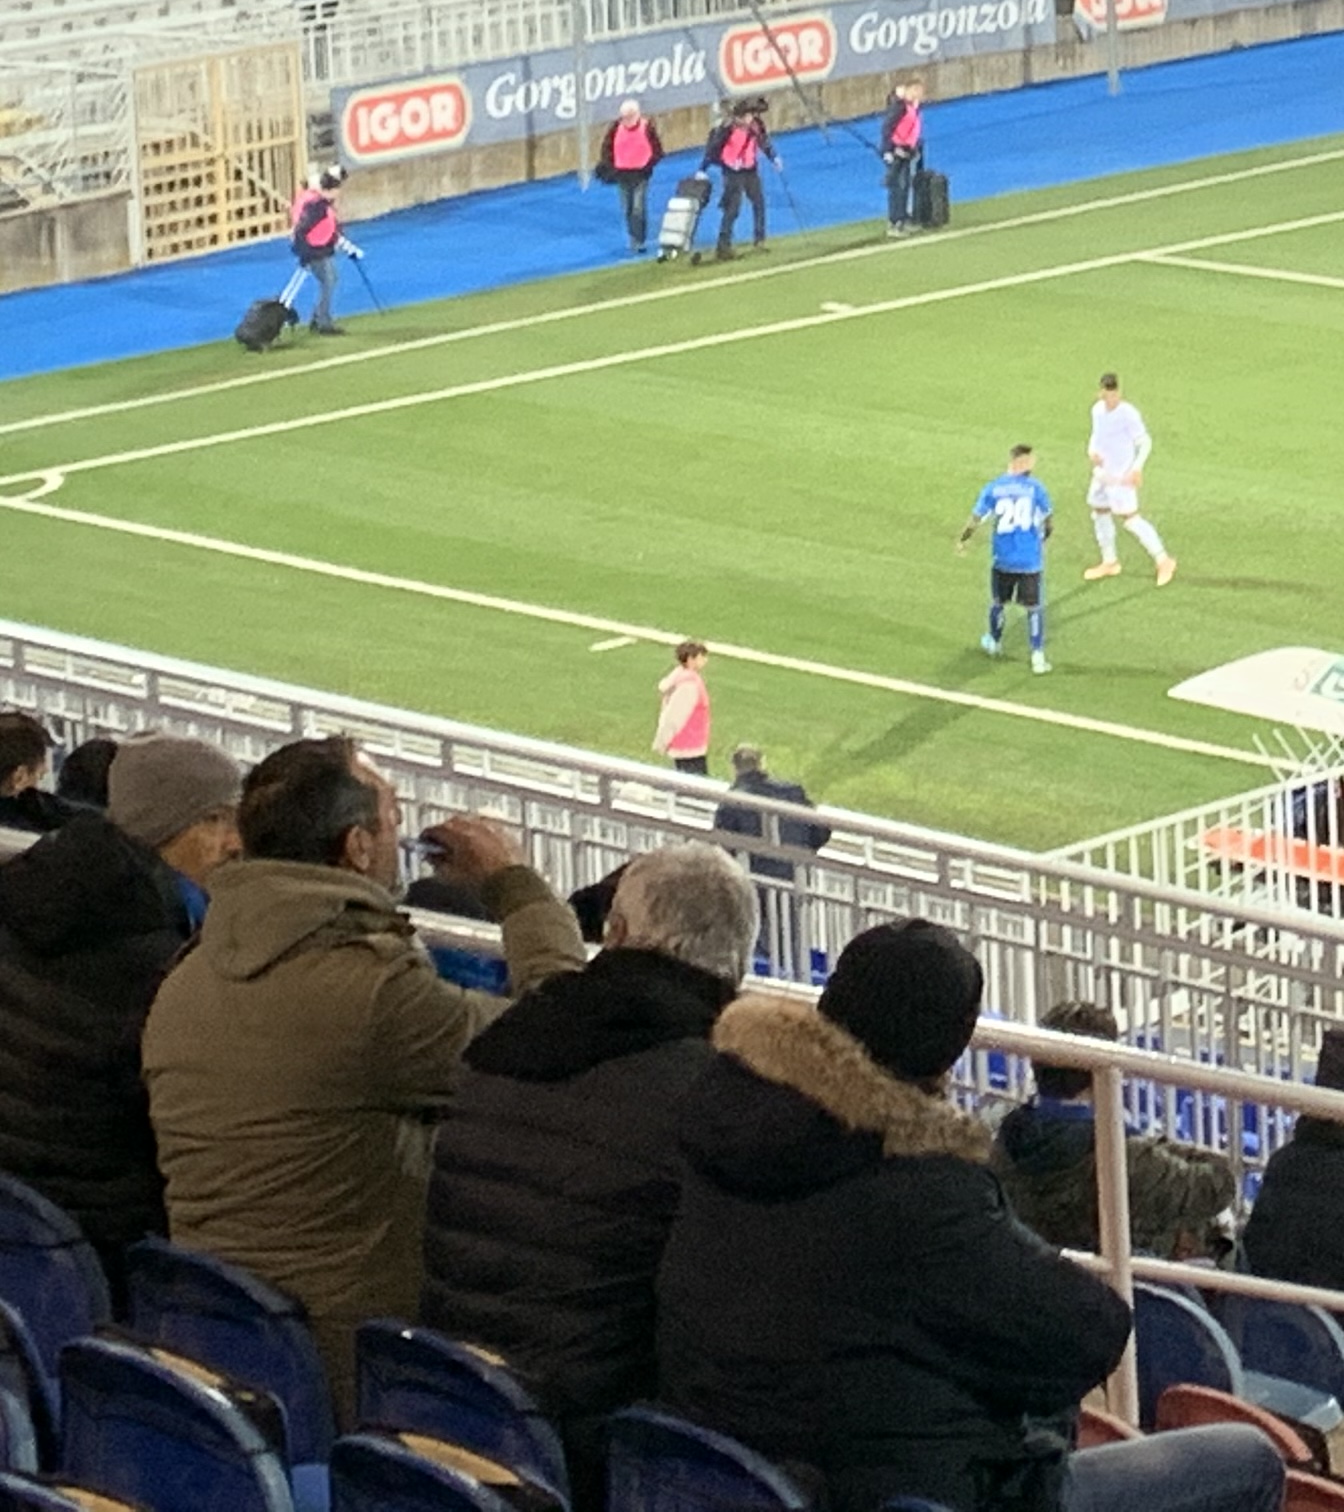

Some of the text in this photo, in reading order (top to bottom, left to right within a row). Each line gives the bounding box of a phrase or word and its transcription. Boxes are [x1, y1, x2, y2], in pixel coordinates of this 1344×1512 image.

[733, 28, 826, 78] IGOR
[356, 41, 706, 146] IGOR Gorgonzola
